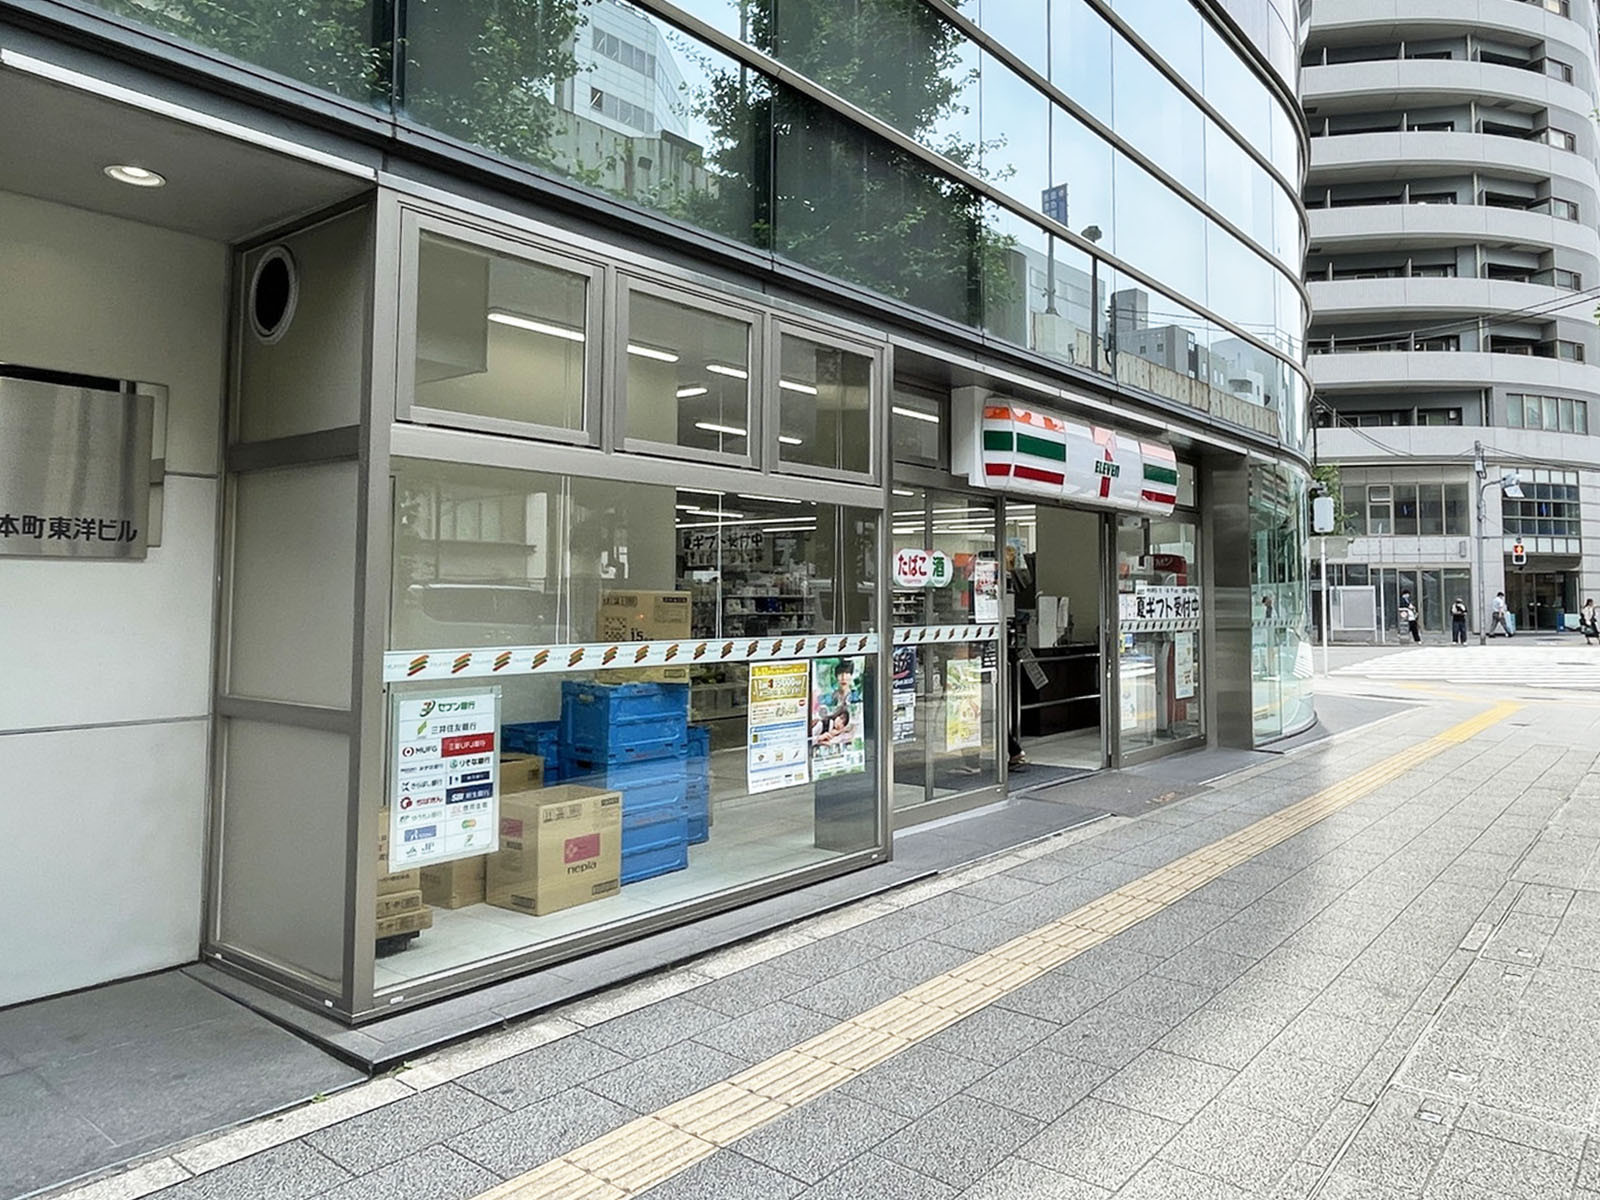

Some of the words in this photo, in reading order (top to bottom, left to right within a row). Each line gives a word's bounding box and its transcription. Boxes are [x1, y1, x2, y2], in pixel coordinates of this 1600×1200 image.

[0, 514, 138, 543] 本町東洋ビル
[898, 554, 927, 577] たばこ
[932, 556, 945, 577] 酒
[1136, 596, 1199, 618] 夏ギフト受付中
[415, 746, 438, 754] MUFG
[567, 862, 597, 875] nepia
